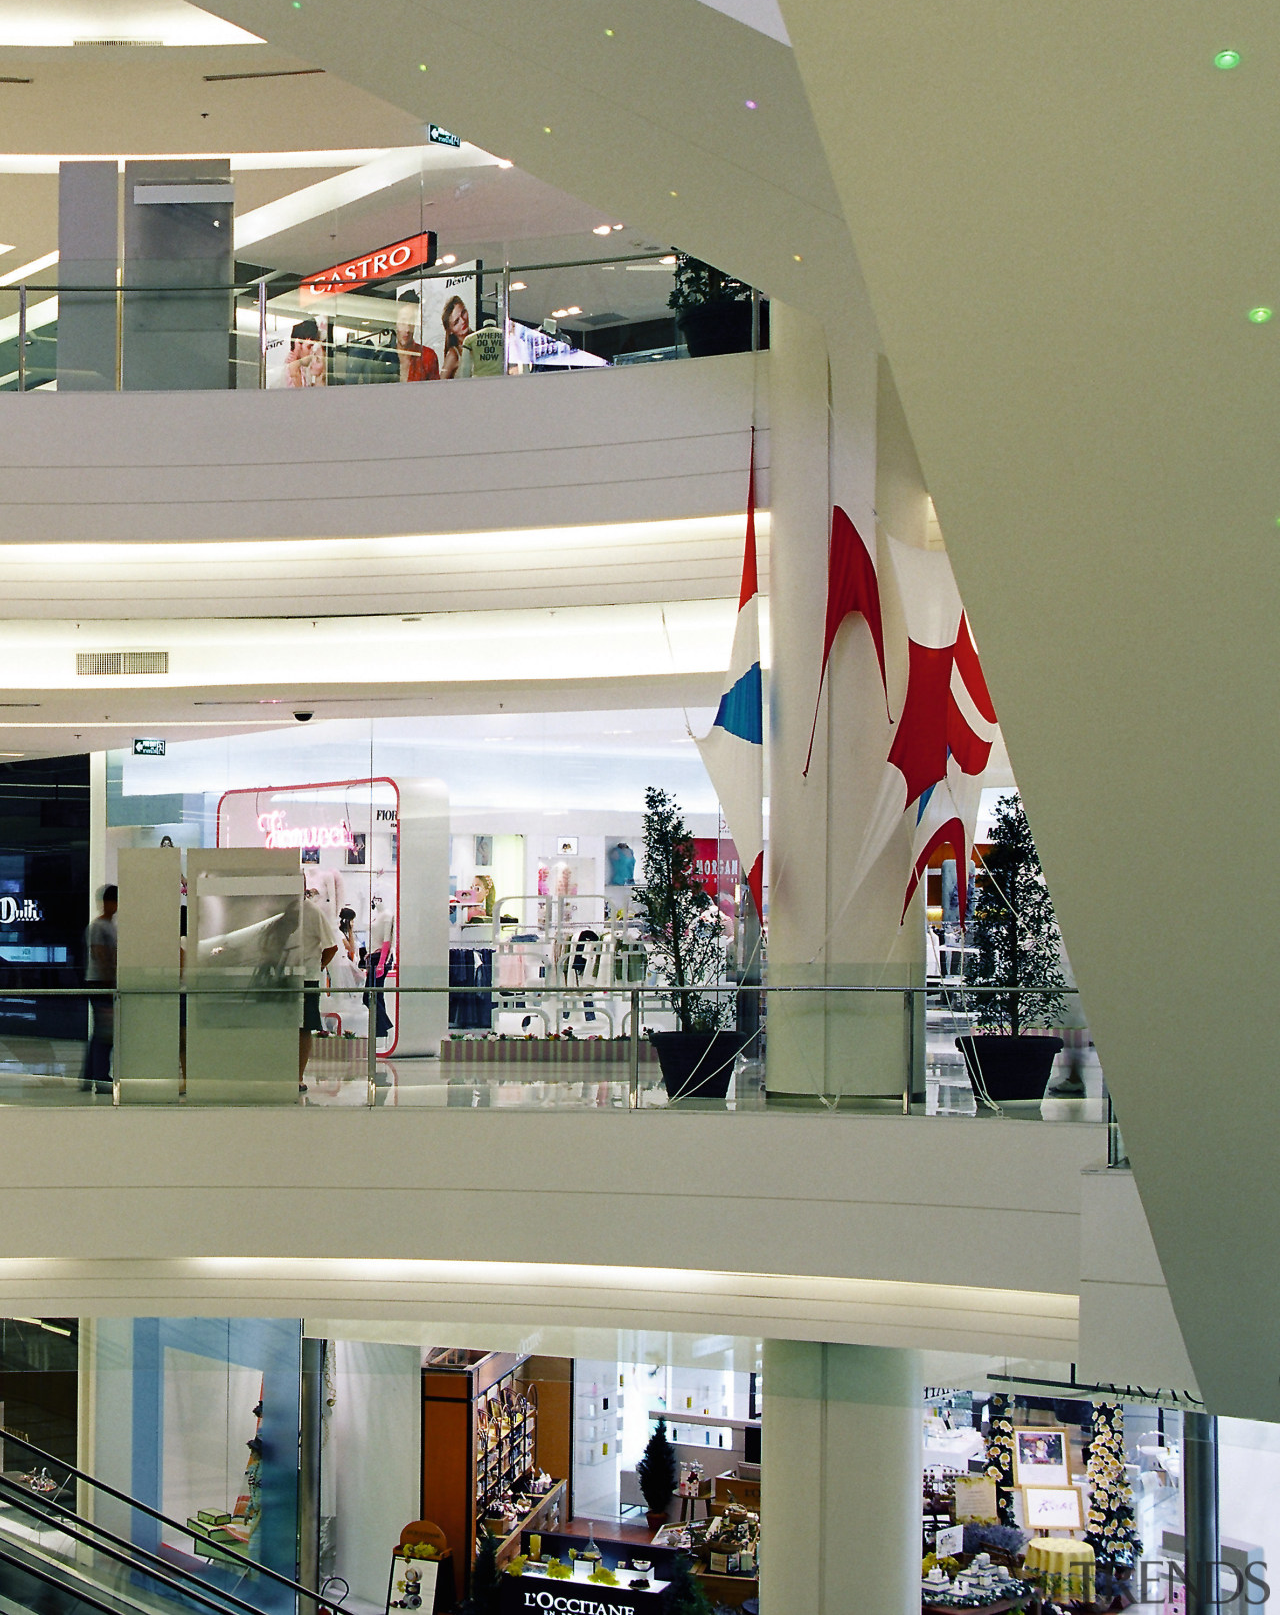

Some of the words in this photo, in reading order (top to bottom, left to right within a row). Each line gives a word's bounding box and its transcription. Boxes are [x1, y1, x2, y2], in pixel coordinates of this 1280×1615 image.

[309, 246, 411, 295] CASTRO
[480, 353, 499, 361] NOW
[695, 859, 738, 875] MORGAN
